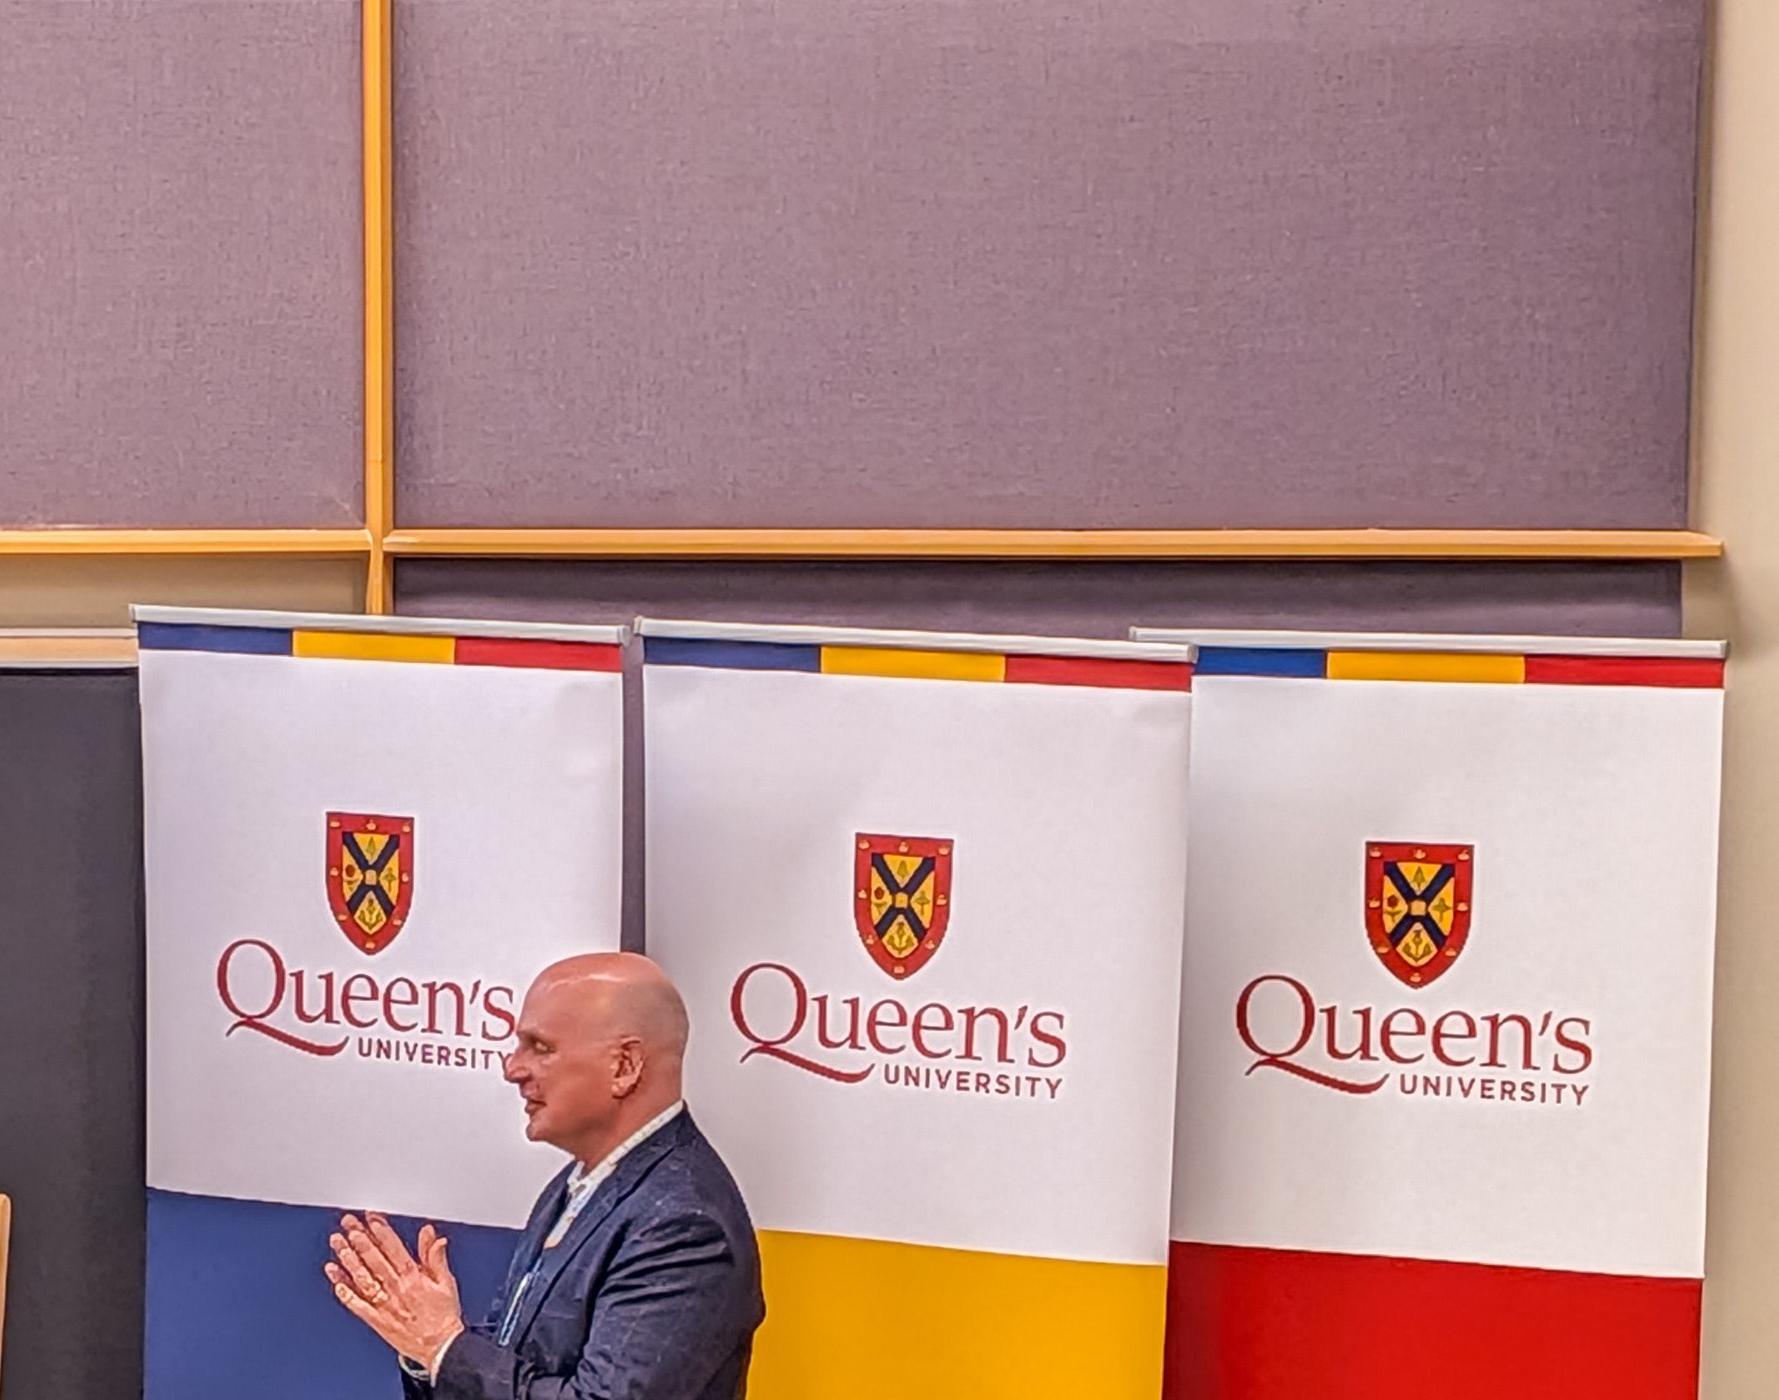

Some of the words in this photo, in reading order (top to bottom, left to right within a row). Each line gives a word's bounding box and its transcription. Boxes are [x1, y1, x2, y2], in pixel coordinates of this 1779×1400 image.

[216, 938, 517, 1057] Queen's
[729, 961, 1067, 1084] Queen's
[1235, 974, 1593, 1095] Queen's
[883, 1062, 1063, 1100] UNIVERSITY
[1399, 1073, 1590, 1106] UNIVERSITY
